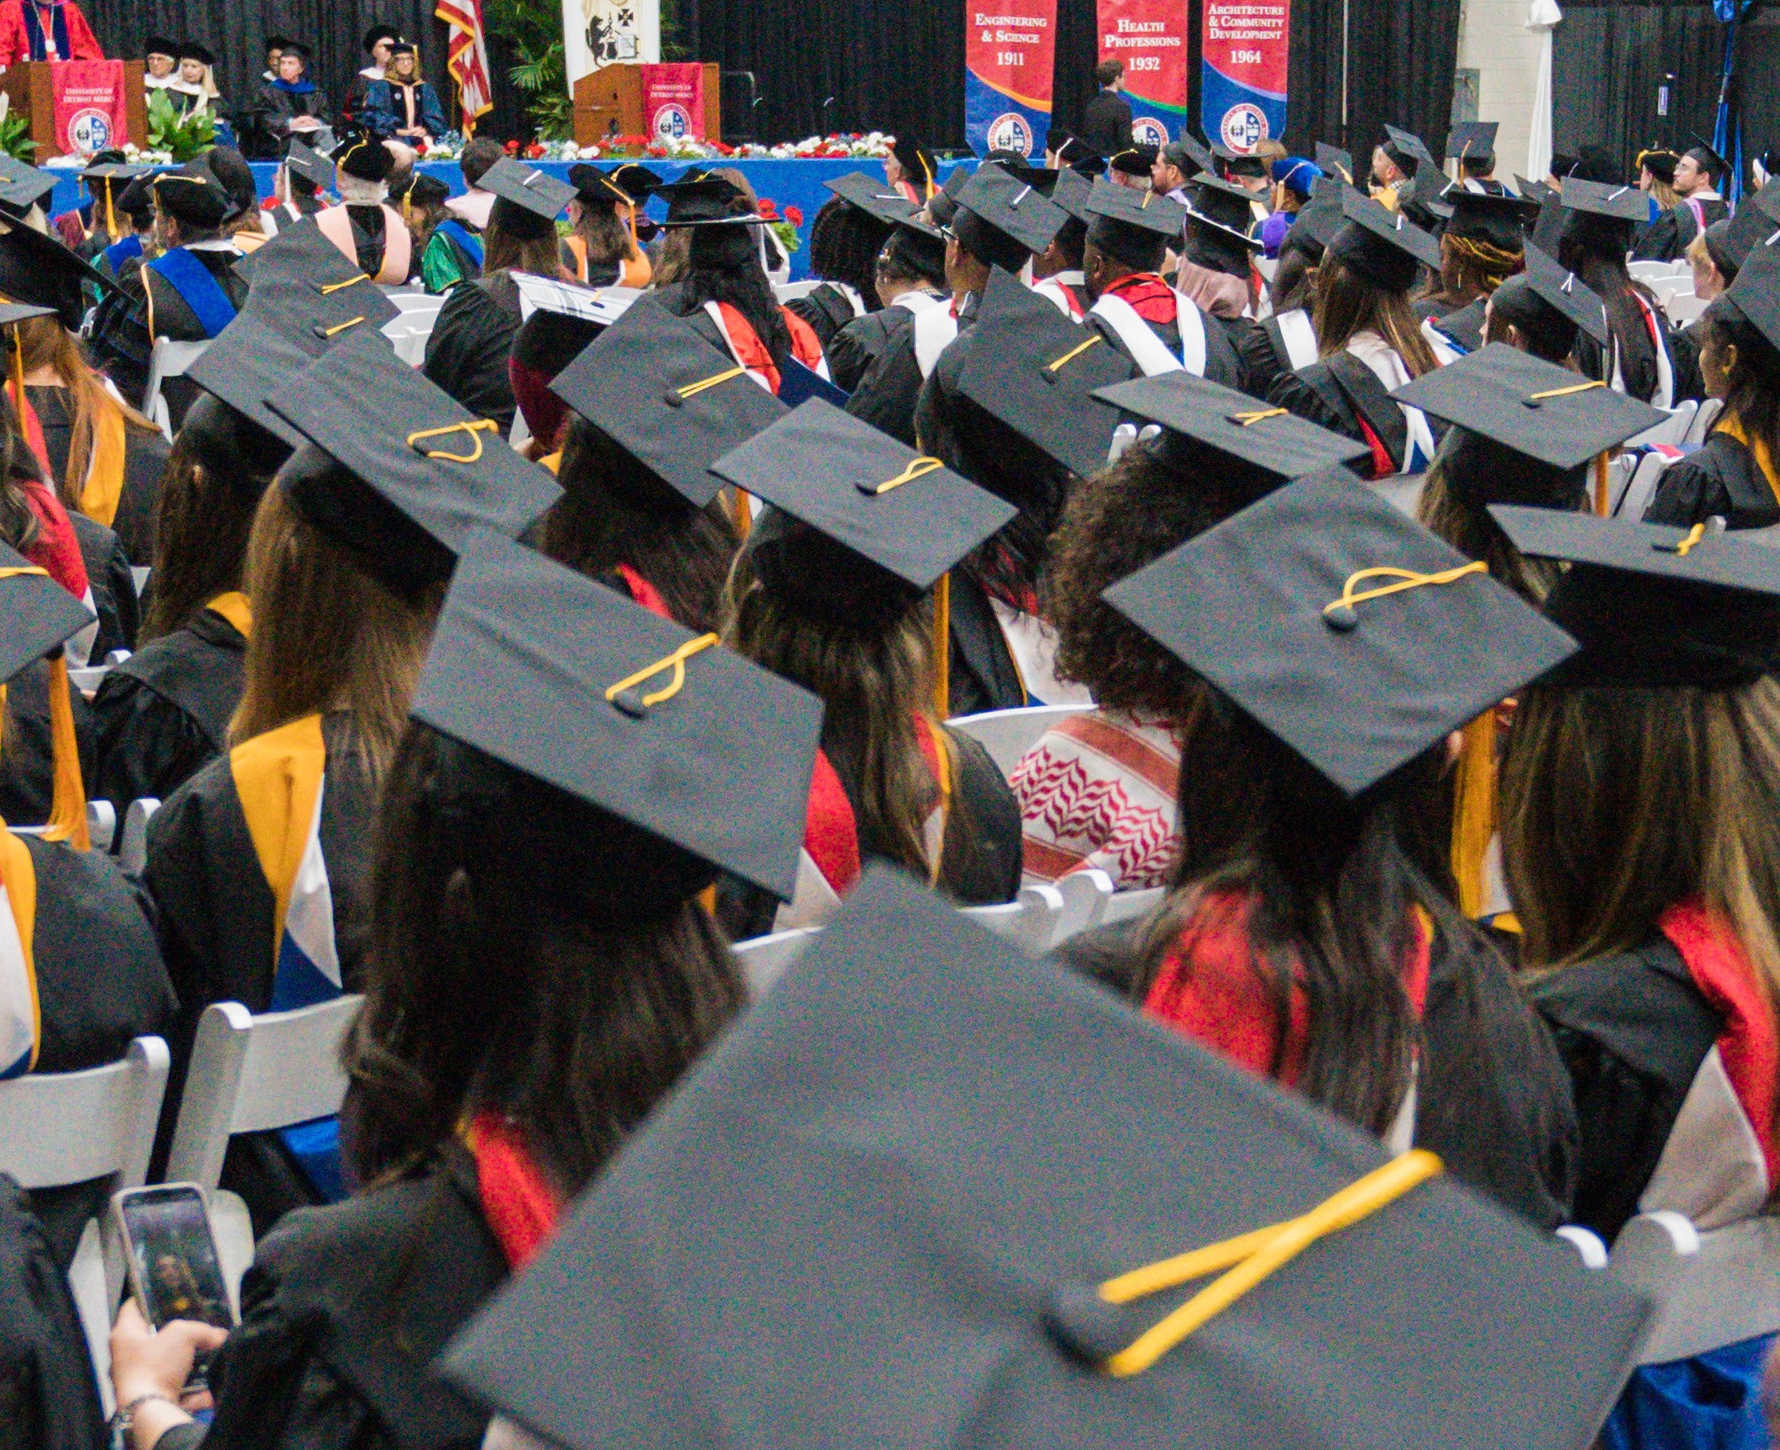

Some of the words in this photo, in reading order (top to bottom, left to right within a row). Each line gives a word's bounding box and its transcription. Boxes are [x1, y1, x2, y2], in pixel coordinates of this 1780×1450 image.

[1208, 3, 1284, 16] ARCHITECTURE
[975, 13, 1047, 28] ENGINEERING
[1118, 19, 1165, 33] HEALTH
[1209, 16, 1218, 27] &
[1221, 16, 1284, 28] COMMUNITY
[981, 30, 993, 43] &
[996, 30, 1039, 44] SCIENCE
[1104, 34, 1181, 48] PROFESSIONS
[1209, 28, 1282, 40] DEVELOPMENT
[997, 52, 1024, 67] 1911
[1128, 57, 1161, 71] 1932
[1230, 50, 1261, 64] 1964
